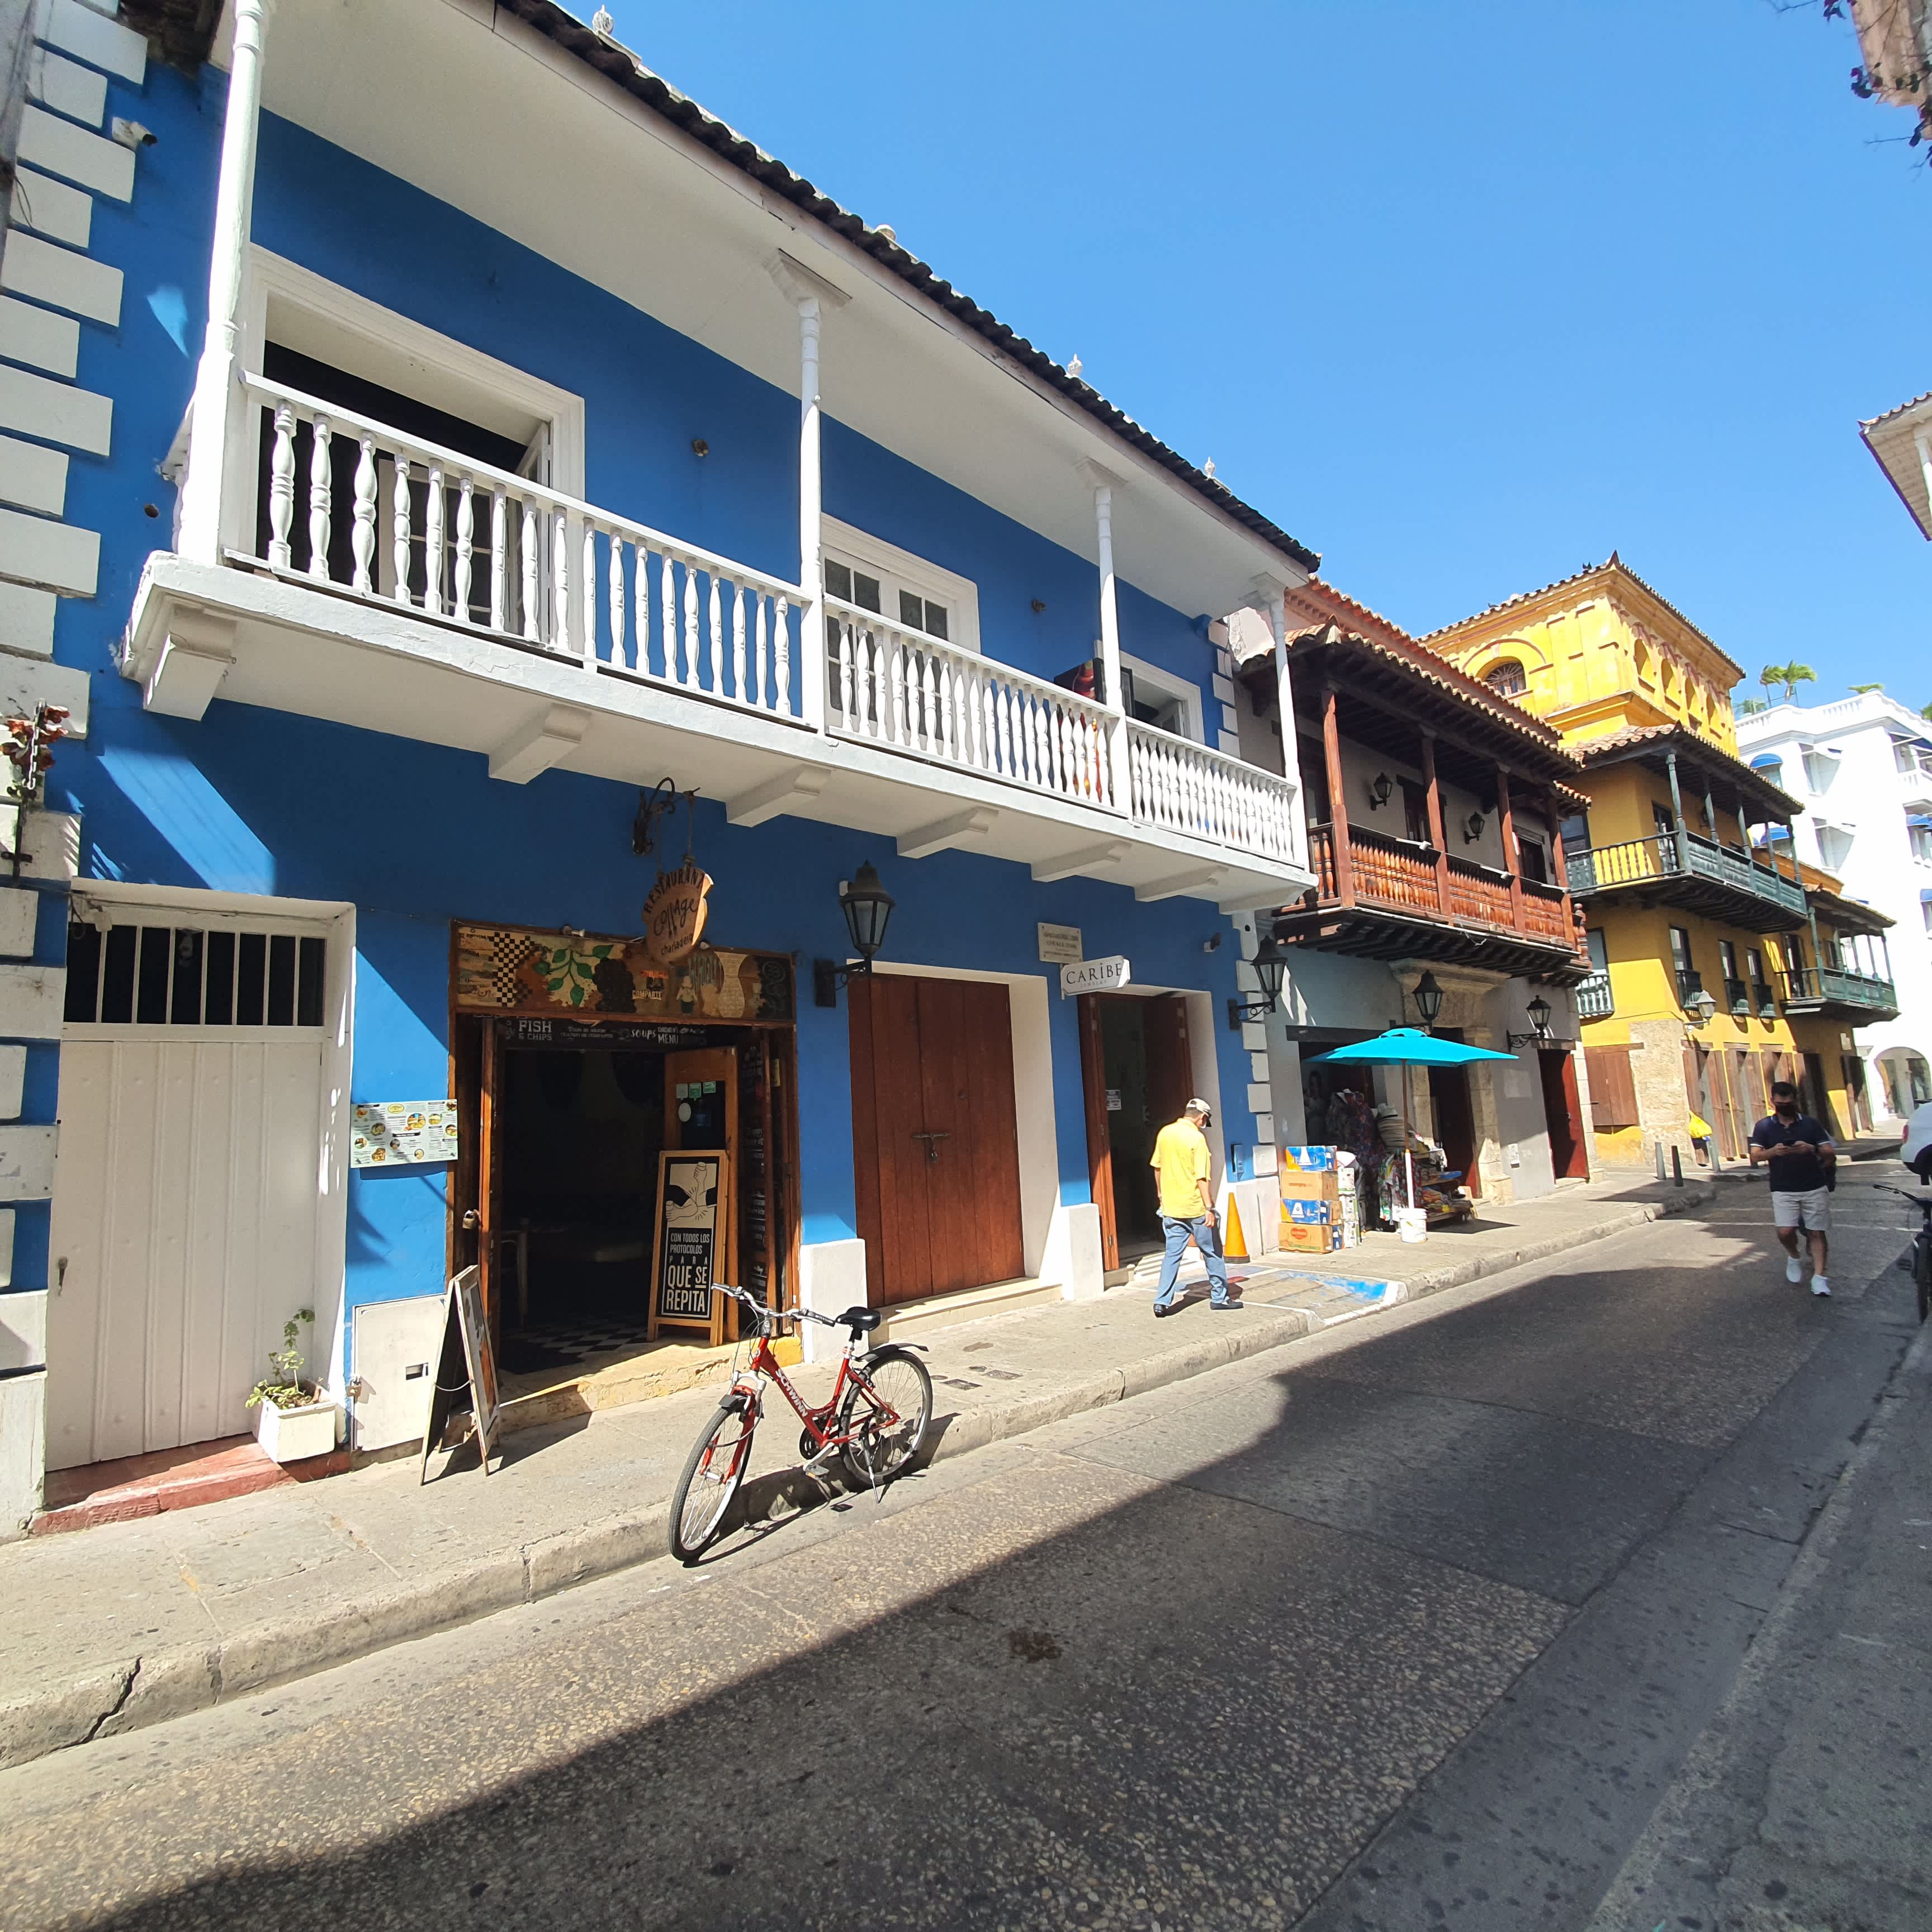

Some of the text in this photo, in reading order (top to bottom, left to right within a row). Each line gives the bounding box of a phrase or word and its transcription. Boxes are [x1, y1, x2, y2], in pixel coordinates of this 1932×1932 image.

[645, 868, 704, 913] RESTAURANT
[519, 1020, 552, 1033] FISH
[658, 1033, 679, 1044] MENU
[671, 1233, 710, 1243] CON TODOS LOS
[670, 1244, 703, 1254] PROTOCOLOS
[669, 1256, 708, 1265] PARA
[667, 1265, 708, 1289] QUE SE
[666, 1289, 705, 1312] REPITA
[775, 1368, 808, 1417] SCHWINN
